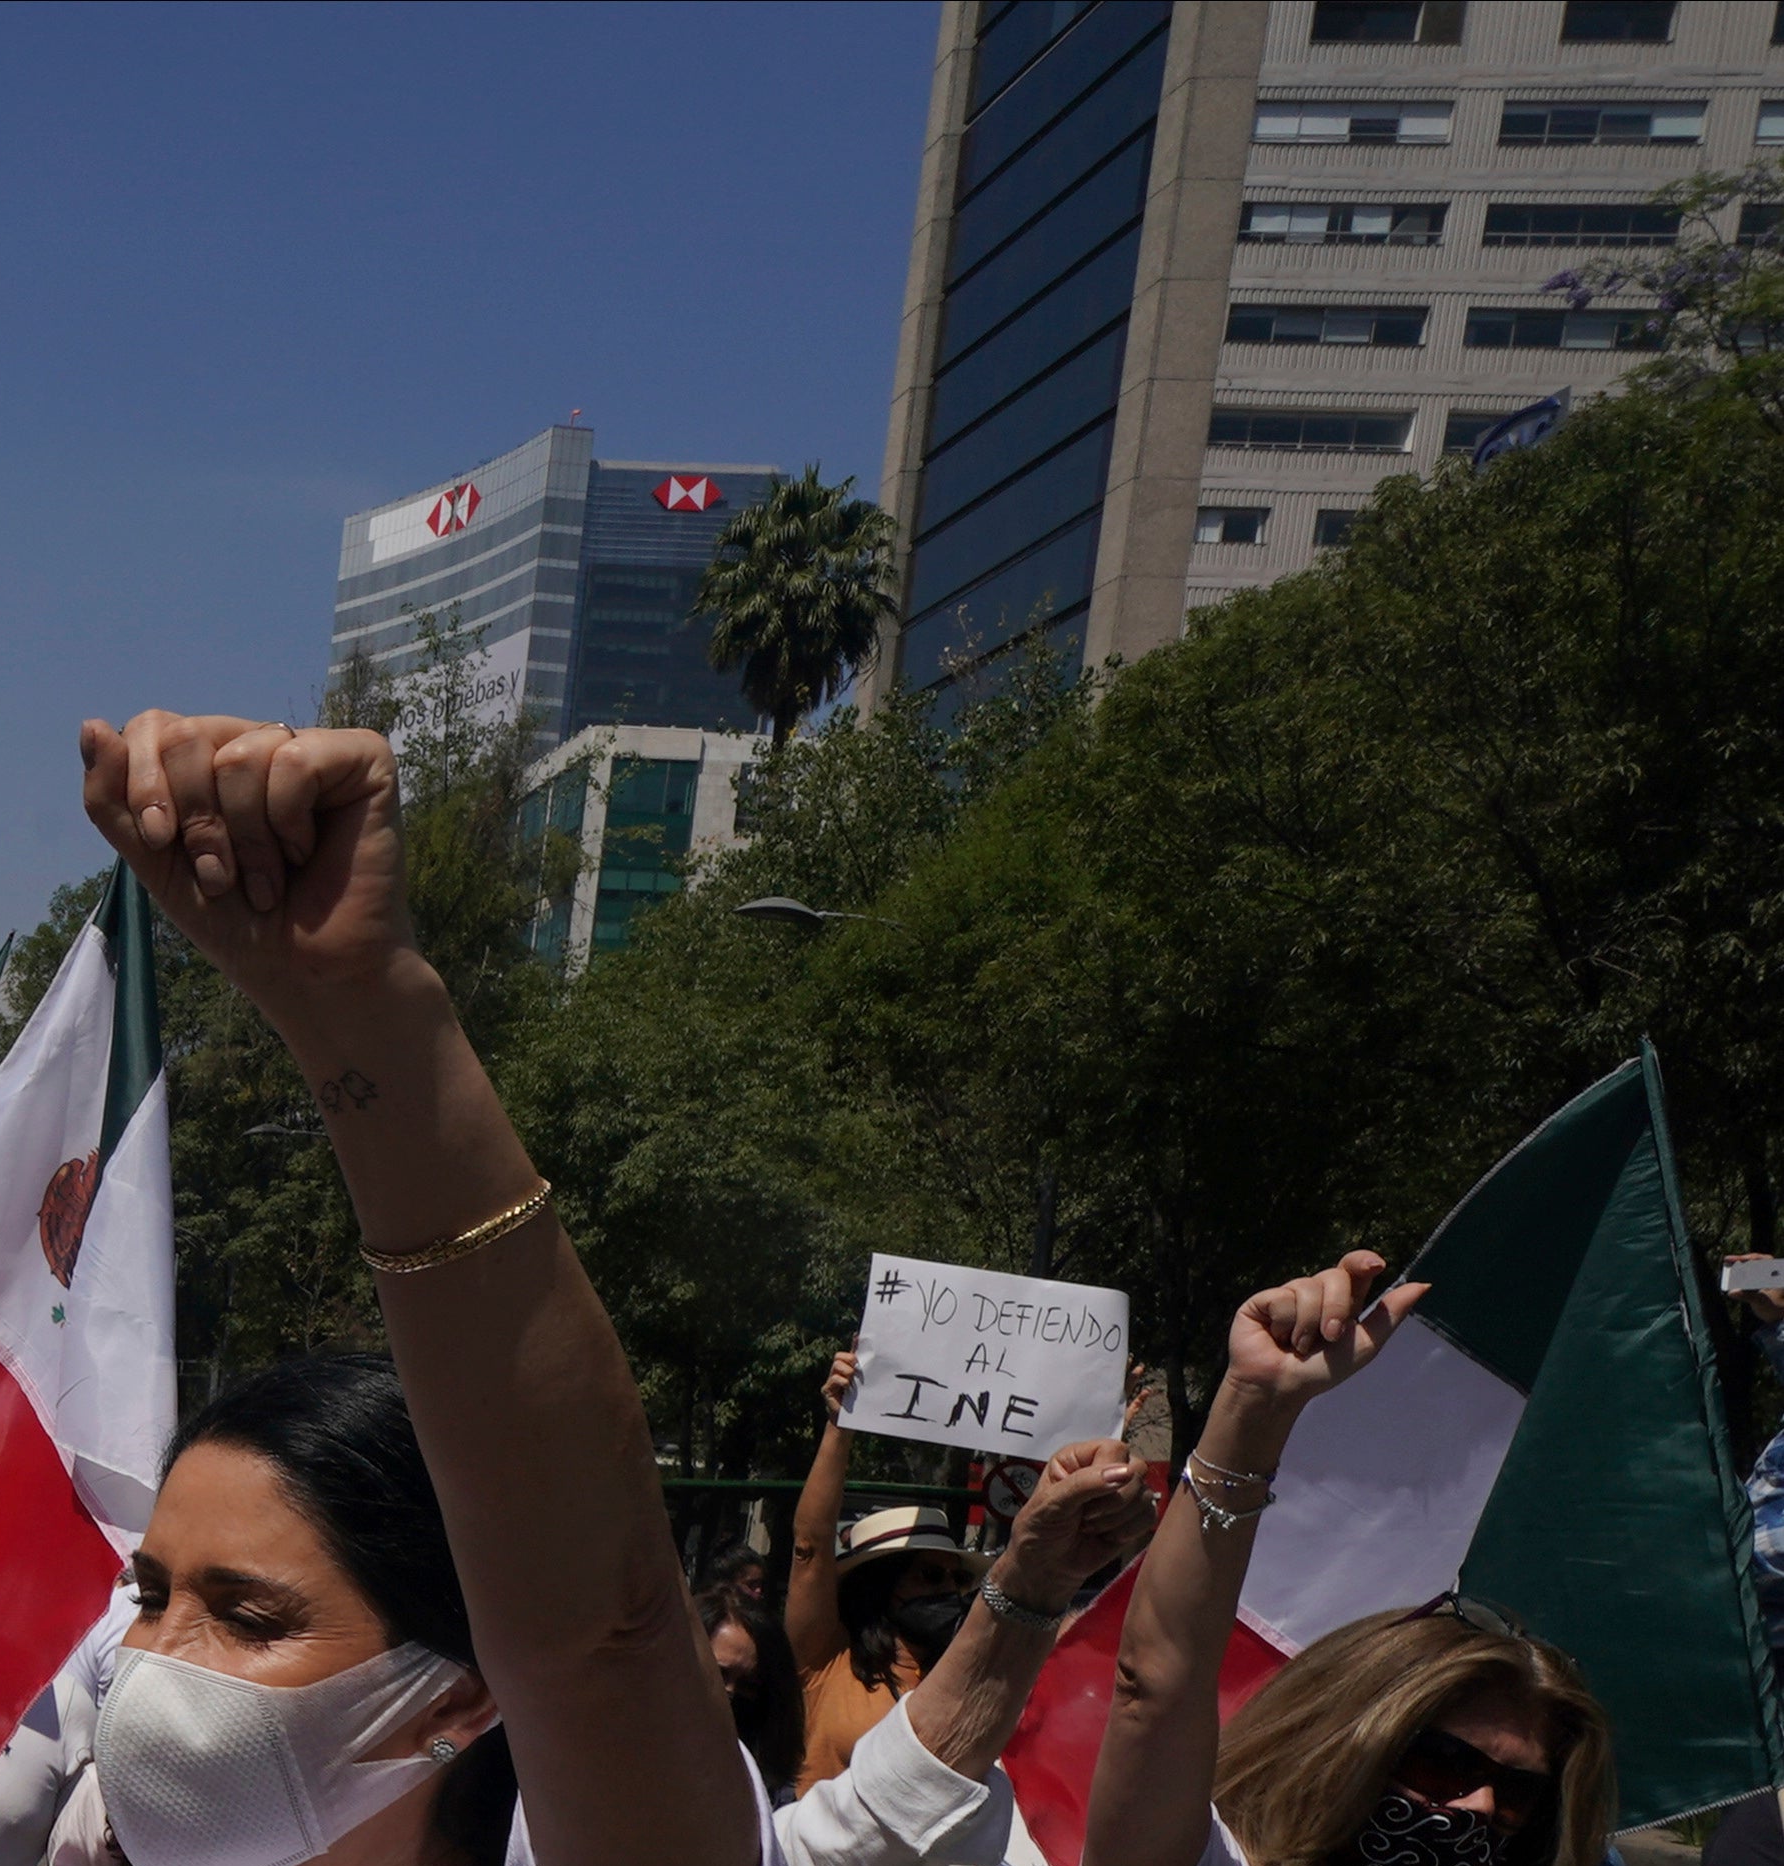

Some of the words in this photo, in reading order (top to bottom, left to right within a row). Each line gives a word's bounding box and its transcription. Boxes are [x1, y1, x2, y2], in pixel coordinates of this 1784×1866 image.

[972, 1292, 1122, 1352] DEFIENDO
[965, 1341, 1016, 1379] AL
[880, 1373, 1040, 1438] INE
